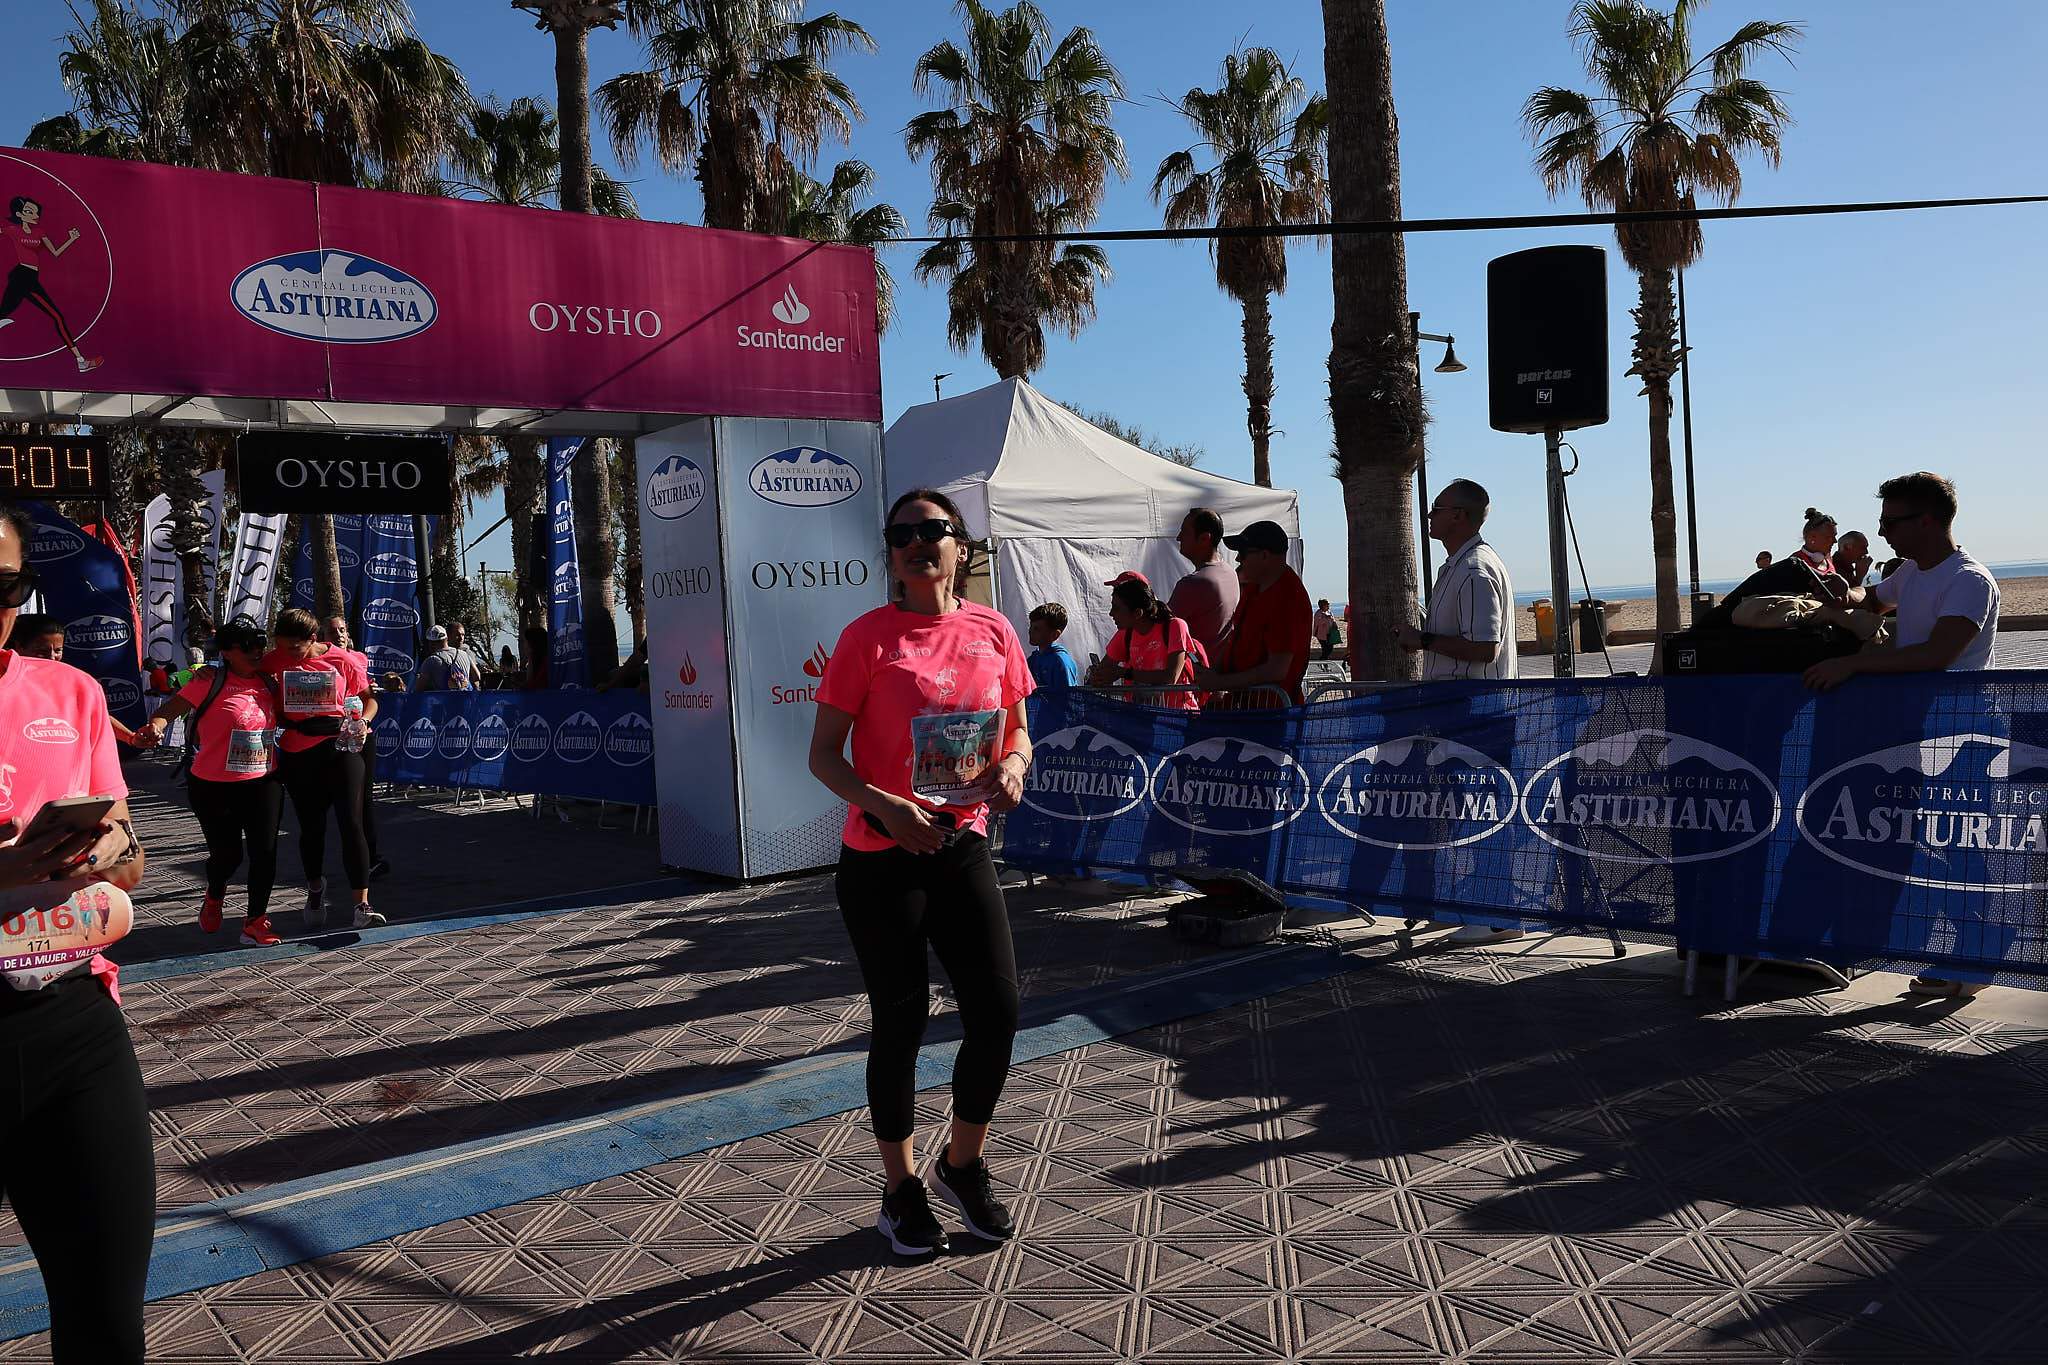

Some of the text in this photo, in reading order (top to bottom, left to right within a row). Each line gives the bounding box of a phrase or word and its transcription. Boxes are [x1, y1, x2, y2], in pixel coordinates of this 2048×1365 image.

[280, 278, 416, 296] CENTRAL LECHERA
[248, 278, 424, 323] ASTURIANA
[529, 302, 662, 338] OYSHO
[737, 325, 845, 353] Santander
[275, 458, 422, 490] OYSHO
[758, 468, 855, 492] ASTURIANA
[813, 467, 851, 475] LECHERA
[650, 482, 701, 507] ASTURIANA
[652, 566, 711, 599] OYSHO
[752, 559, 869, 589] OYSHO
[65, 630, 128, 643] ASTURIANA
[664, 690, 713, 709] Santander
[557, 729, 597, 750] ASTURIANA
[1024, 756, 1136, 799] ASTURIANA
[1240, 767, 1294, 781] LECHERA
[1363, 773, 1423, 785] CENTRAL
[1663, 775, 1751, 792] LECHERA
[1160, 765, 1295, 811] ASTURIANA
[1330, 774, 1499, 821] ASTURIANA
[1874, 784, 1983, 802] CENTRAL
[1536, 775, 1756, 833] ASTURIANA
[1819, 785, 2048, 851] ASTURIA
[27, 940, 51, 952] 171
[4, 959, 17, 970] DE
[20, 957, 32, 967] LA
[34, 952, 67, 965] MUJER
